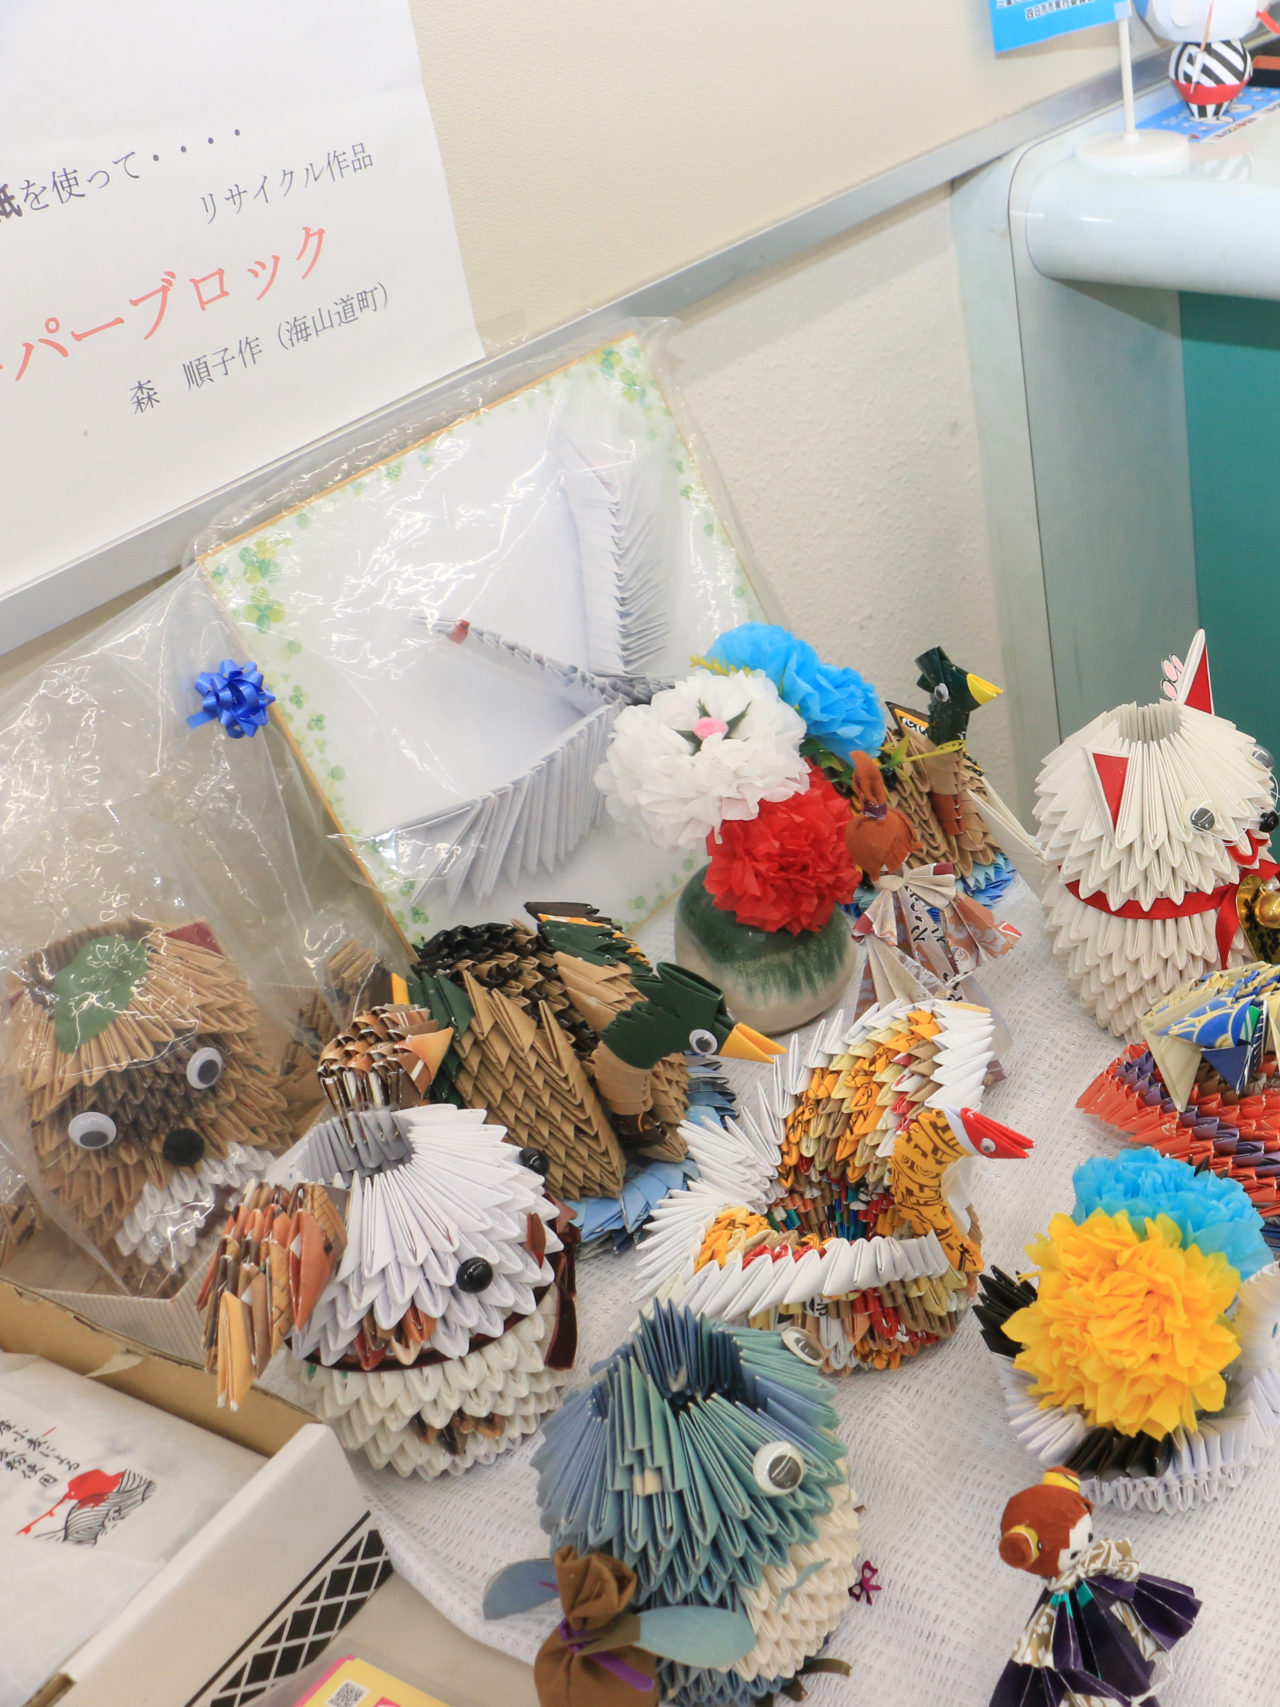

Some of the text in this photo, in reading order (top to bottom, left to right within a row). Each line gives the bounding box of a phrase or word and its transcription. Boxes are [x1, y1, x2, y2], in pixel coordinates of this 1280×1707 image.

[200, 142, 375, 225] リサイクル作品
[0, 226, 326, 382] パーブロック
[129, 380, 161, 415] 森
